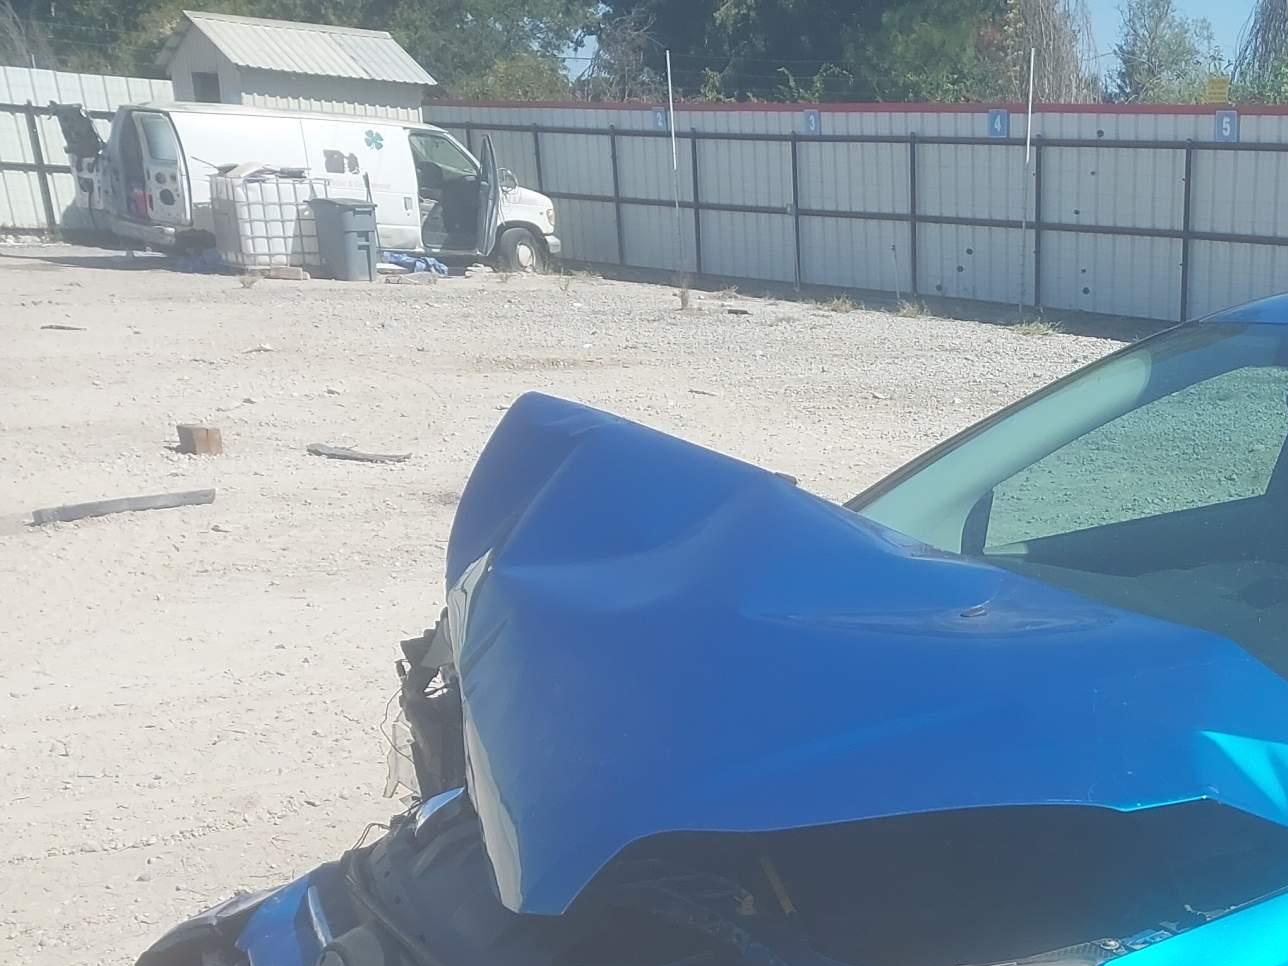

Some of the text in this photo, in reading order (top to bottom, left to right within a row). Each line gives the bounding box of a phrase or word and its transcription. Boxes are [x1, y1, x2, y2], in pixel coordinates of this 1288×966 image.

[656, 112, 664, 127] 2
[808, 115, 816, 130] 3
[994, 114, 1001, 131] 4
[1222, 116, 1231, 136] 5
